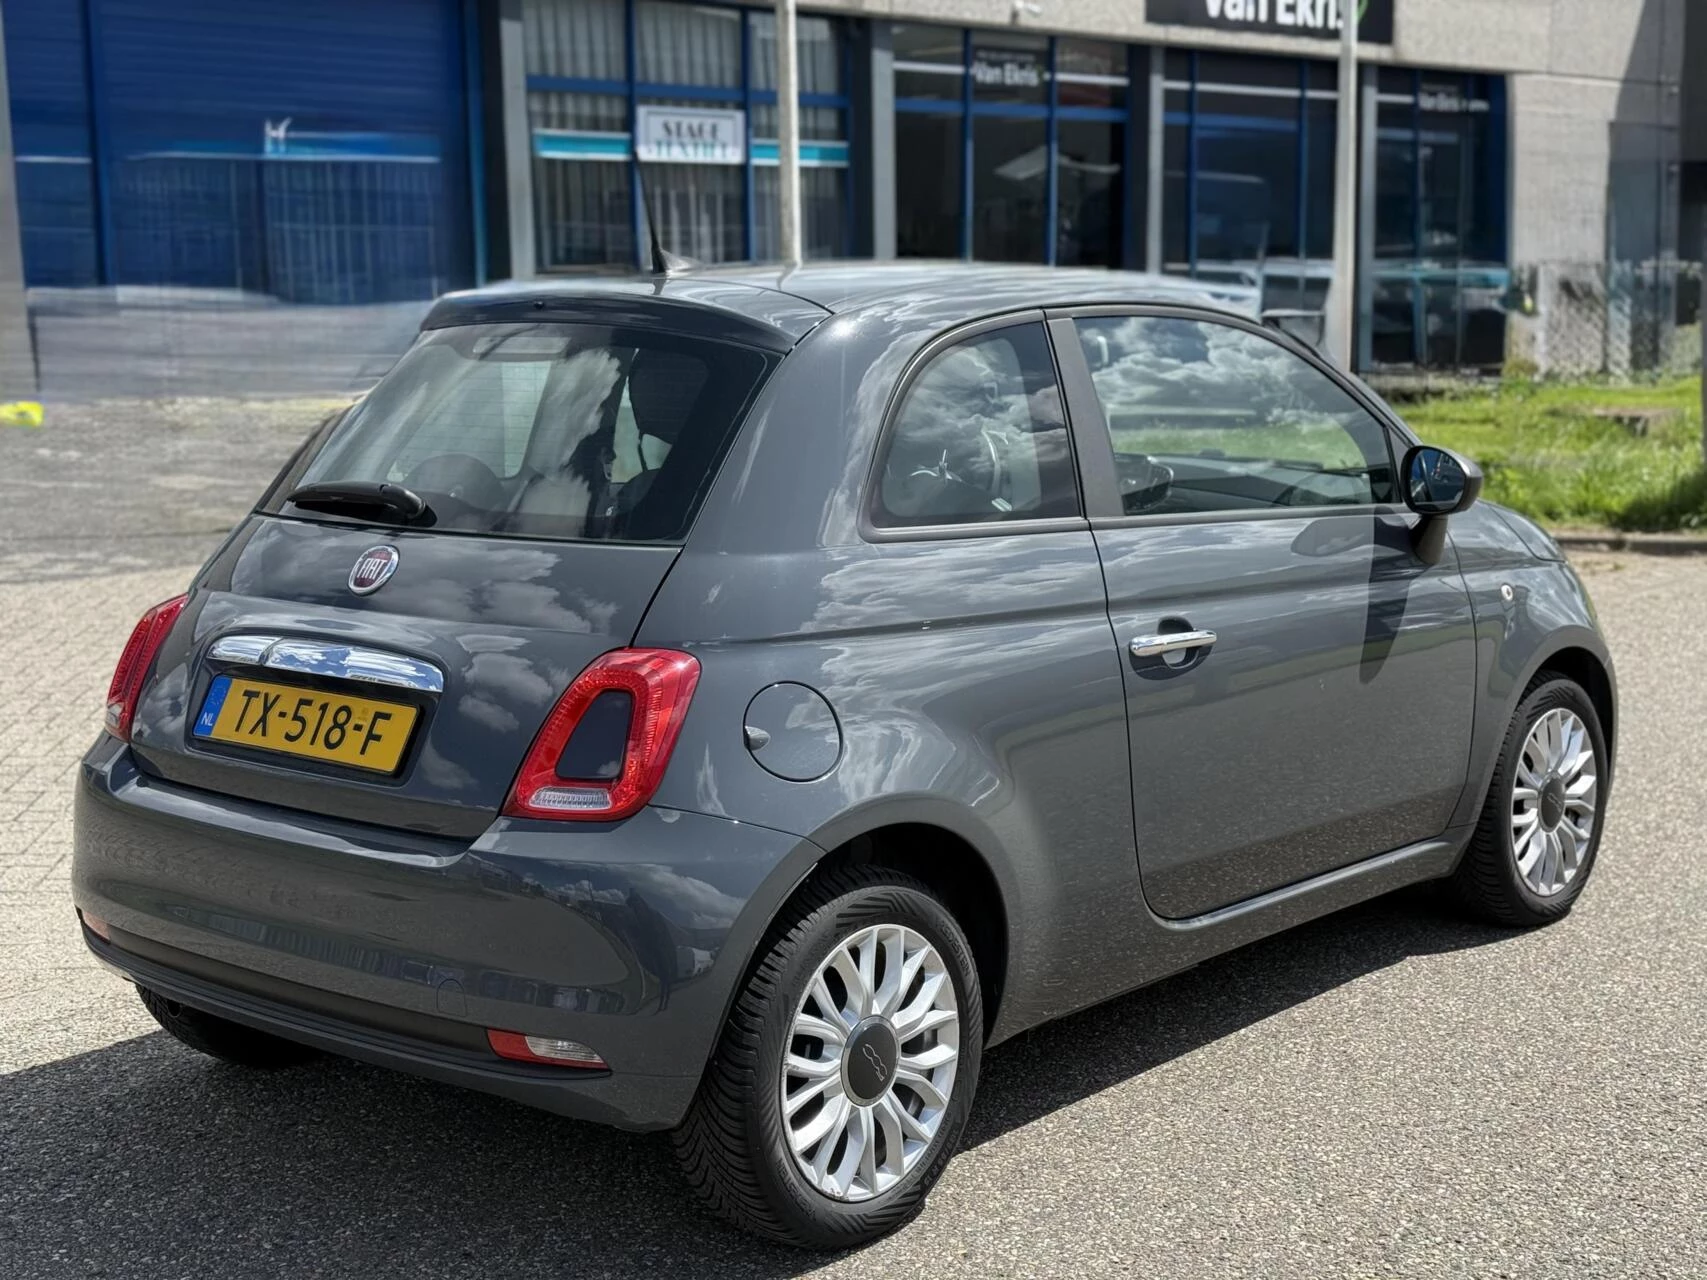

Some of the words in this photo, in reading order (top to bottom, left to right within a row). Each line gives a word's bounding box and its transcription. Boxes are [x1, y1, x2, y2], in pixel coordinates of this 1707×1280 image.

[1205, 0, 1268, 23] Van
[356, 557, 388, 580] FIAT
[200, 711, 214, 727] NL
[235, 689, 392, 756] TX-518-F
